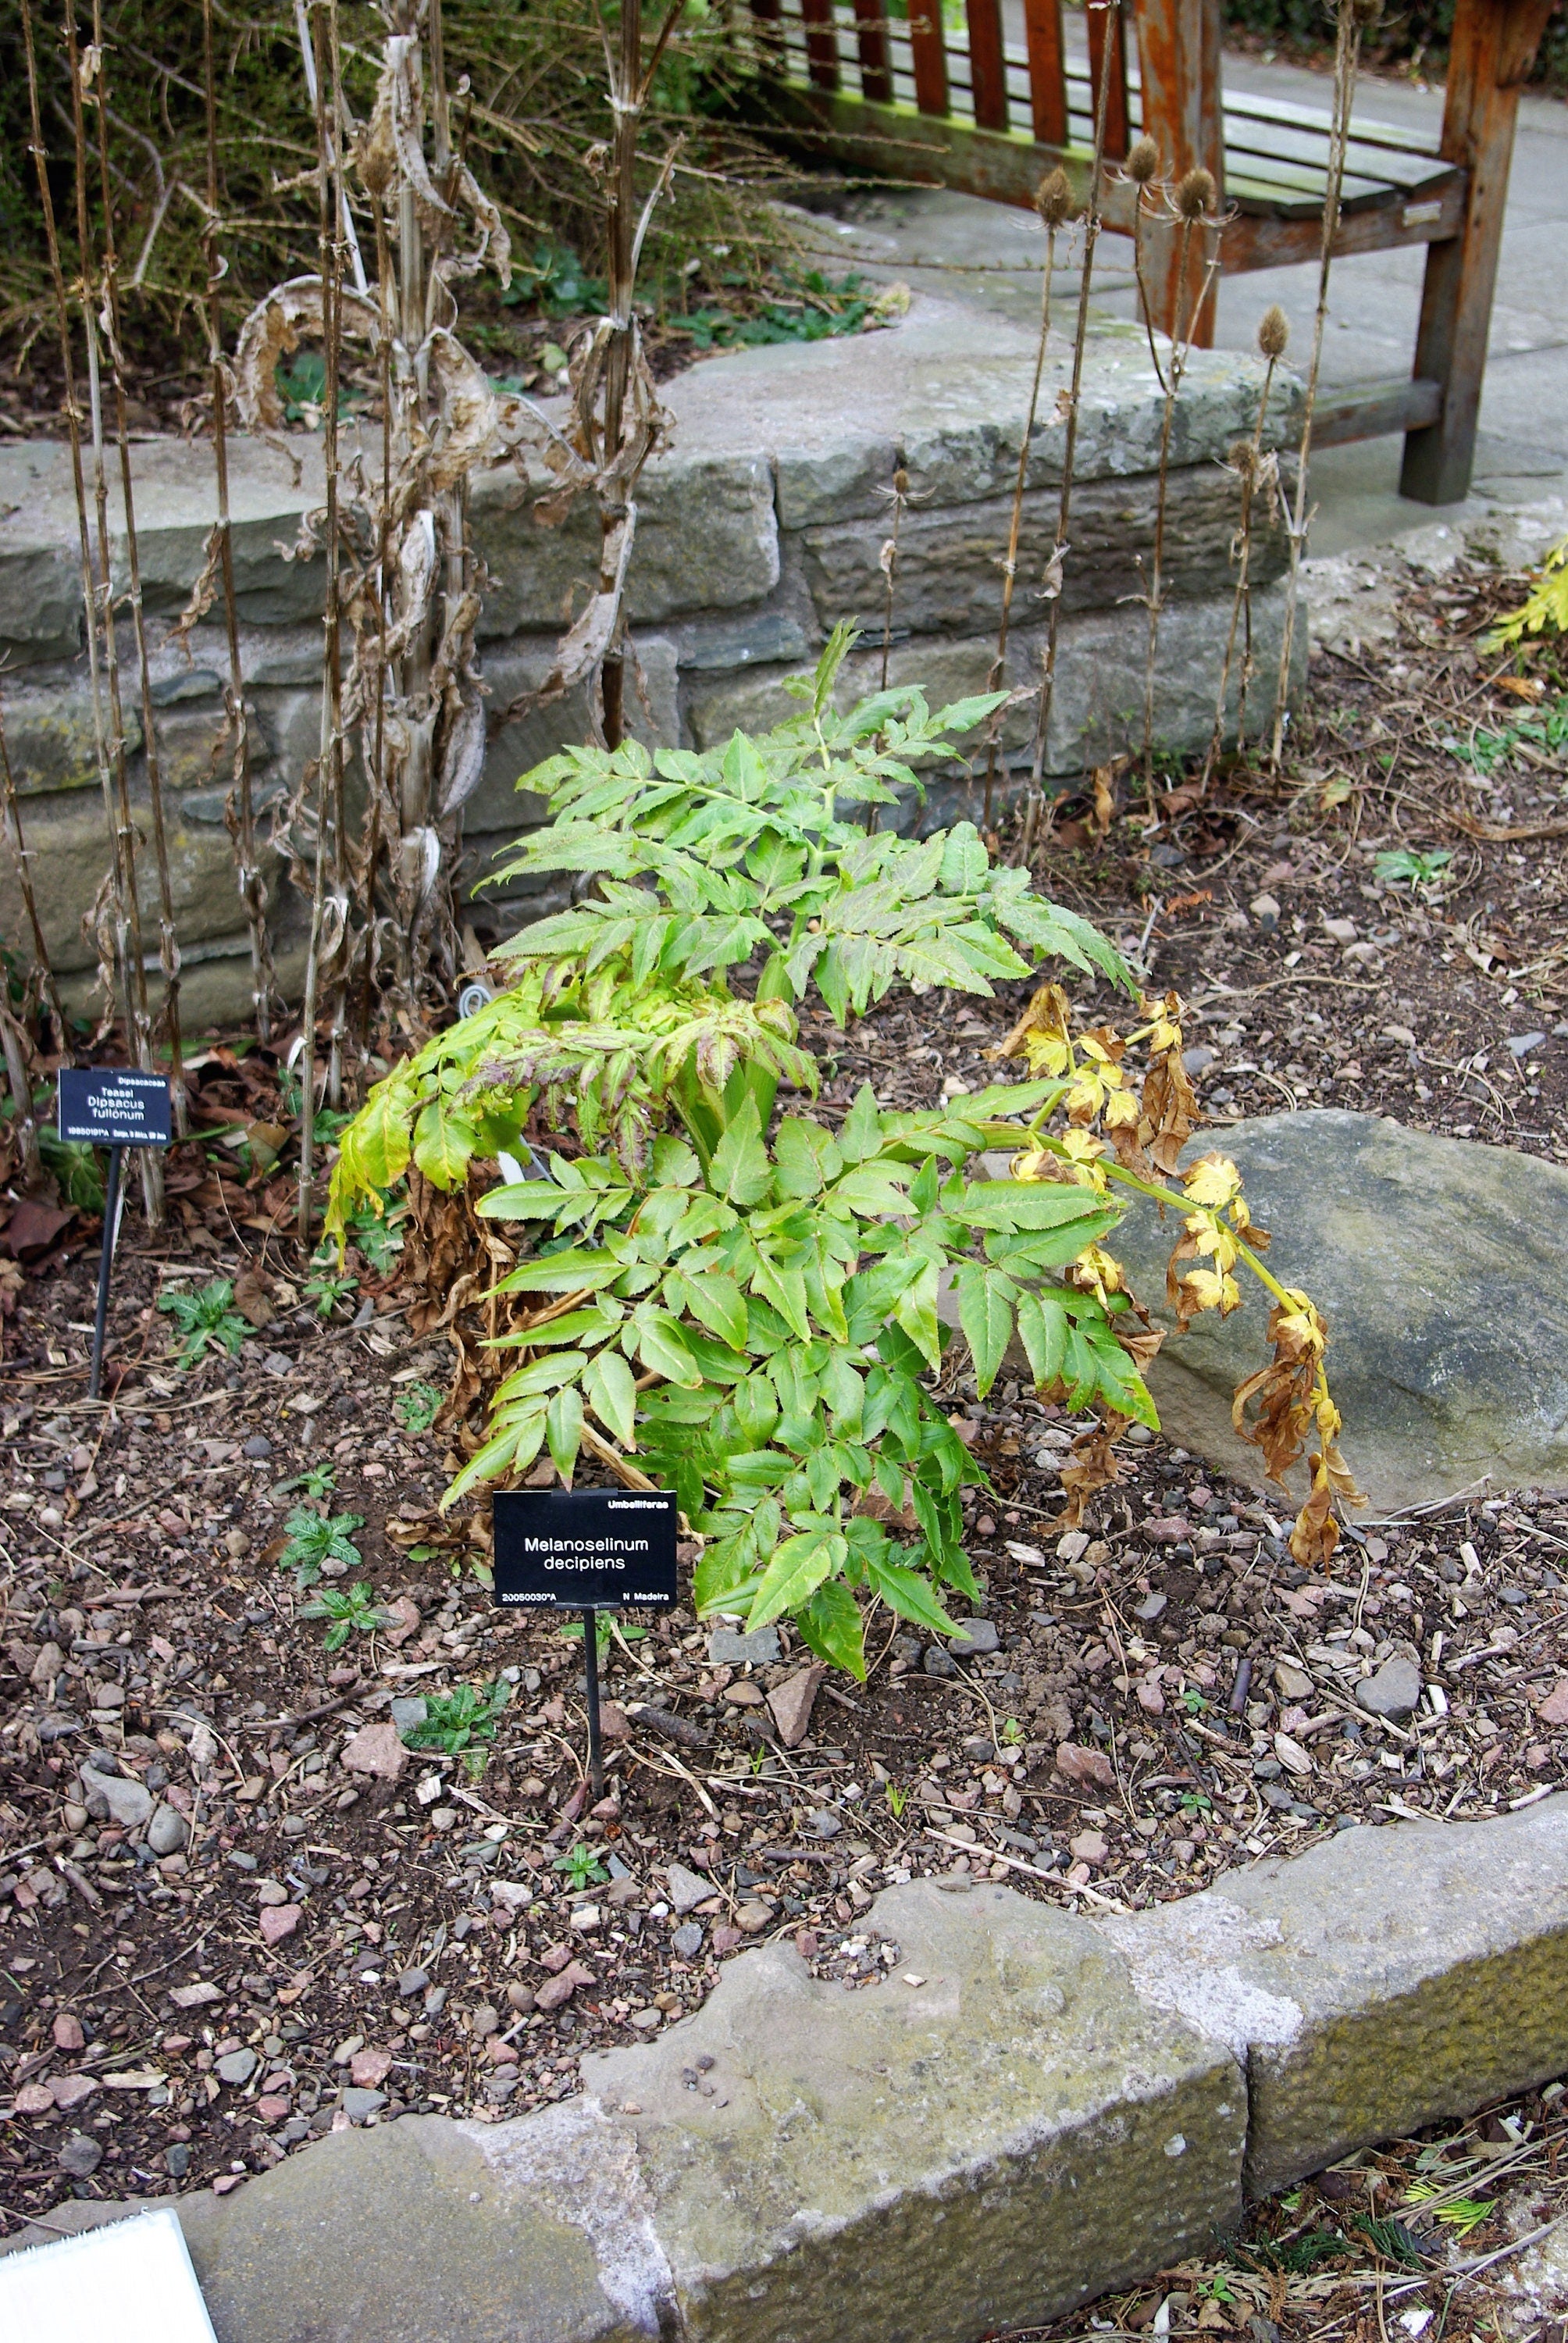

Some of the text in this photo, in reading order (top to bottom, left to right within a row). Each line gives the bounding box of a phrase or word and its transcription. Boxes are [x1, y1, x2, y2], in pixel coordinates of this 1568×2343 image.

[102, 1086, 134, 1098] Teasel
[87, 1096, 145, 1110] Dipsacus
[92, 1107, 144, 1121] fullonum
[608, 1500, 669, 1510] Umbelliferae
[524, 1537, 649, 1552] Melanoselinum
[543, 1556, 625, 1571] decipiens
[622, 1592, 669, 1601] N Madeira
